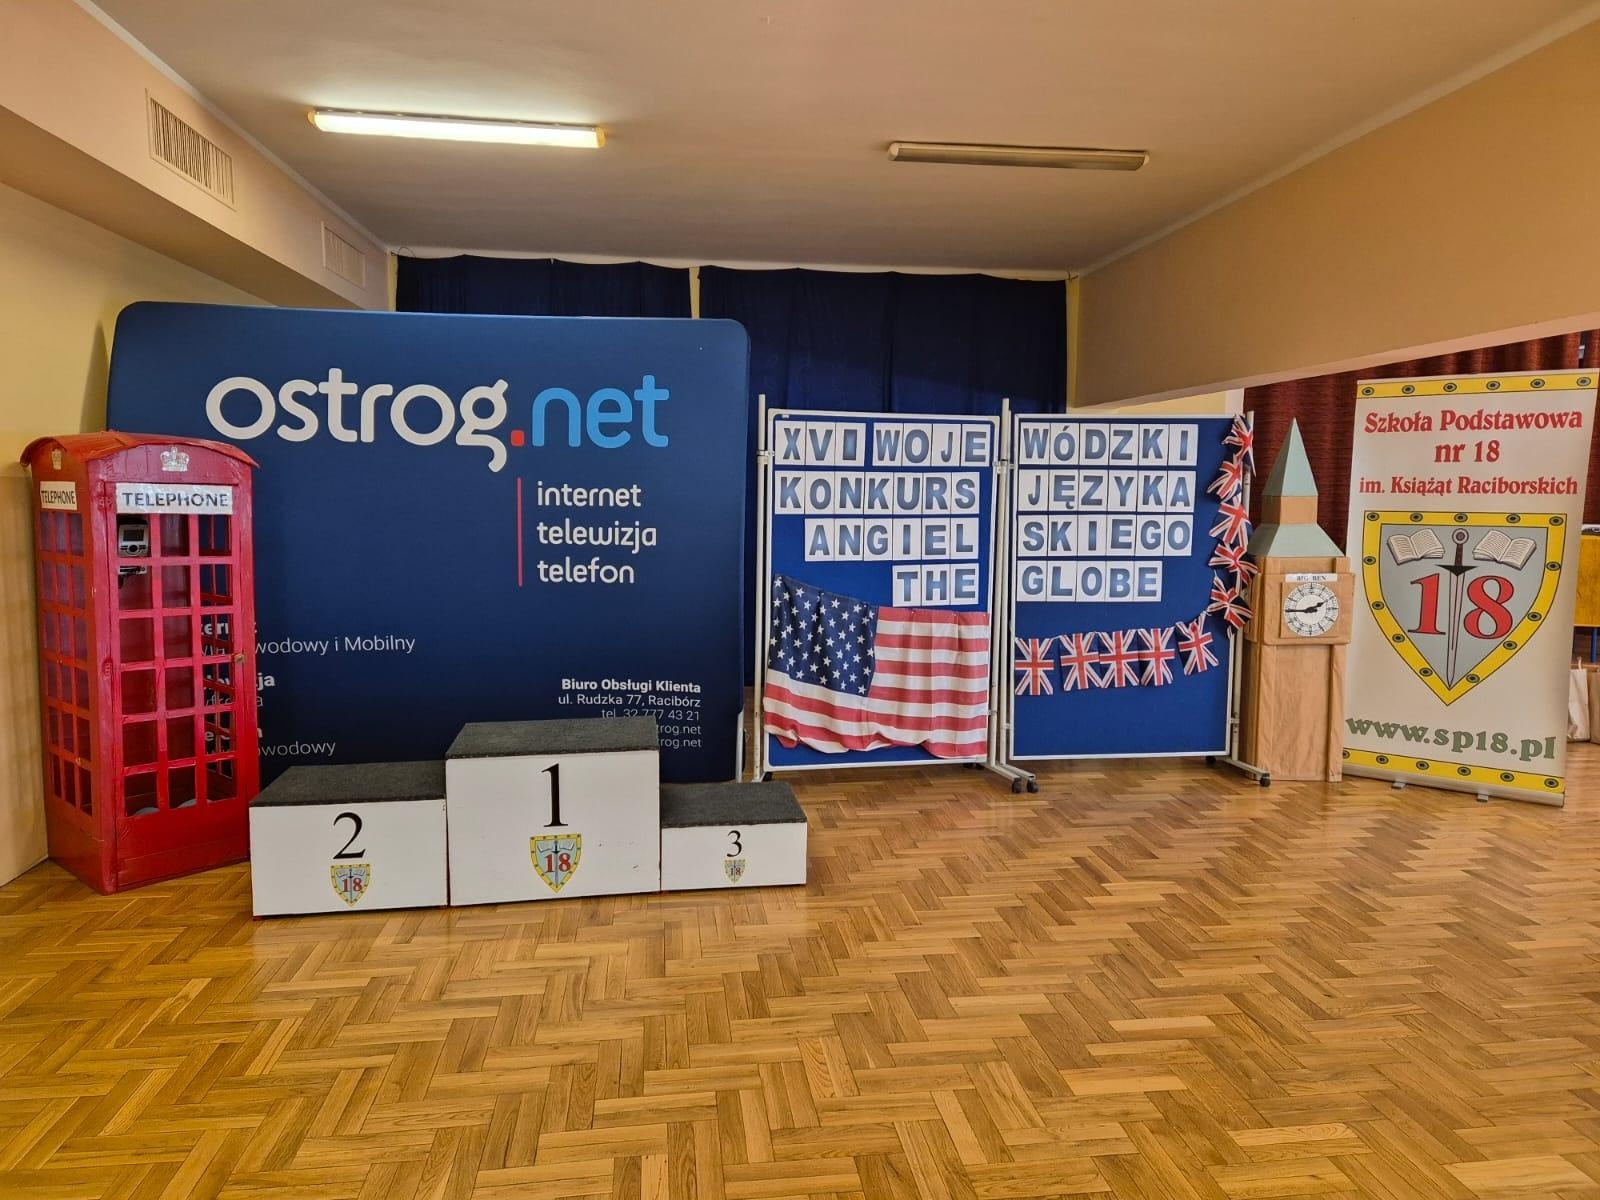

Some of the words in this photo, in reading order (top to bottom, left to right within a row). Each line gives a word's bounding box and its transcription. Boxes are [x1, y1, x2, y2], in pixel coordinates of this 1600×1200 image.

[206, 368, 669, 472] ostrog.net
[1364, 411, 1433, 433] Szkoła
[1439, 409, 1583, 431] Podstawowa
[783, 428, 858, 461] XVI
[876, 429, 987, 464] WOJE
[1023, 425, 1189, 461] WÓDZKI
[1434, 443, 1465, 463] nr
[1474, 440, 1500, 463] 18
[40, 490, 76, 505] TELEPHONE
[122, 492, 229, 507] TELEPHONE
[537, 481, 642, 508] internet
[780, 476, 976, 510] KONKURS
[1027, 475, 1191, 509] JĘZYKA
[1359, 477, 1385, 494] im.
[1390, 476, 1453, 497] Książąt
[1457, 475, 1578, 495] Raciborskich
[537, 518, 657, 554] telewizja
[808, 523, 974, 556] ANGIEL
[1022, 519, 1191, 552] SKIEGO
[537, 557, 635, 584] telefon
[896, 568, 976, 602] THE
[1021, 565, 1158, 598] GLOBE
[1408, 572, 1515, 639] 18
[335, 637, 339, 651] i
[345, 635, 416, 653] Mobilny
[561, 678, 598, 690] Biuro
[601, 679, 652, 693] Obsługi
[656, 680, 701, 693] Klienta
[558, 694, 573, 705] ul.
[577, 694, 623, 705] Rudzka
[626, 695, 645, 707] 77,
[648, 695, 701, 708] Racibórz
[668, 709, 683, 720] 43
[686, 710, 700, 721] 21
[1345, 717, 1557, 762] www.sp18.pl
[541, 763, 568, 828] 1
[332, 812, 366, 859] 2
[726, 830, 742, 857] 3
[544, 852, 571, 873] 18
[341, 877, 362, 892] 18
